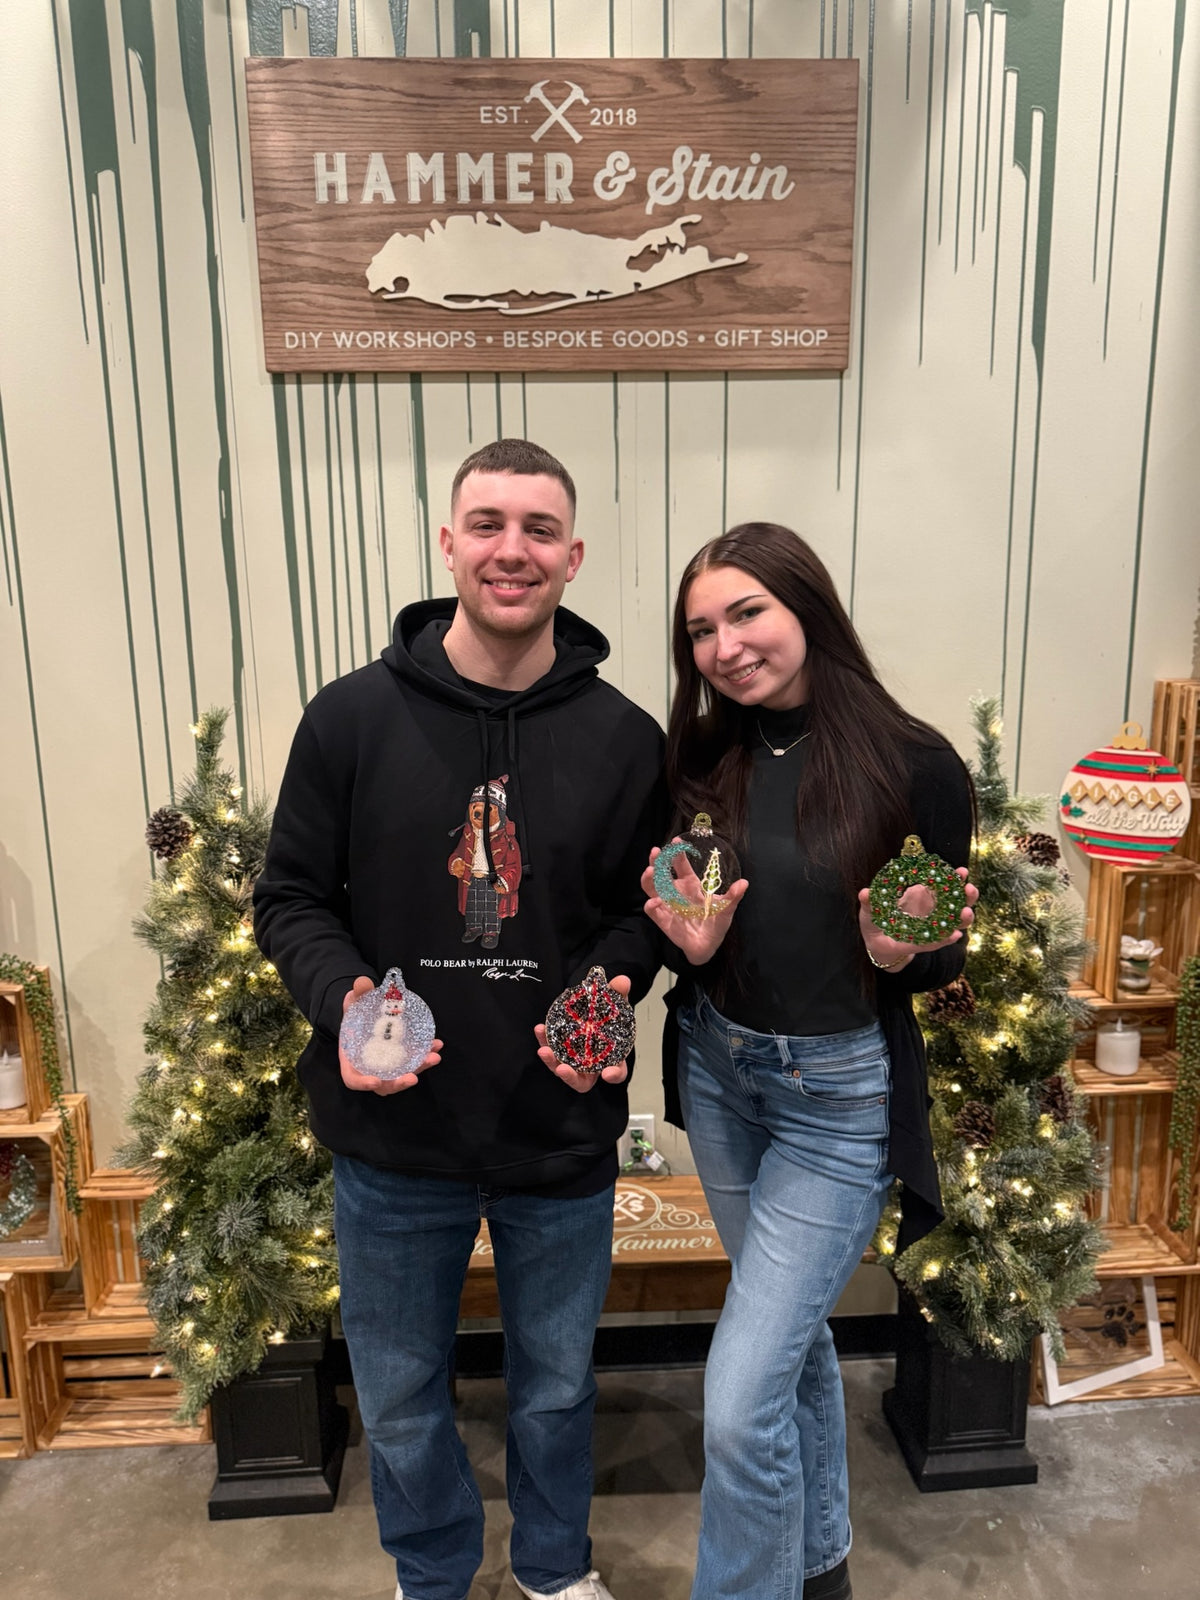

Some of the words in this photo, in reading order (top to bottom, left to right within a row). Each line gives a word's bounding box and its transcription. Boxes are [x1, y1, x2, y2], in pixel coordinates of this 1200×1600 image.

[480, 106, 529, 124] EST.
[590, 108, 637, 126] 2018
[313, 152, 575, 204] HAMMER
[593, 151, 637, 201] &
[645, 145, 796, 215] Stain
[284, 331, 323, 349] DIY
[332, 330, 477, 349] WORKSHOPS
[503, 330, 603, 348] BESPOKE
[612, 330, 688, 348] GOODS
[714, 329, 762, 347] GIFT
[770, 329, 828, 347] SHOP
[1074, 784, 1177, 807] JINGLE
[1085, 806, 1110, 827] all
[1111, 810, 1137, 831] the
[1136, 811, 1187, 838] Way
[420, 958, 441, 968] POLO
[443, 959, 467, 968] BEAR
[468, 959, 475, 969] by
[476, 958, 504, 968] RALPH
[506, 959, 538, 970] LAUREN
